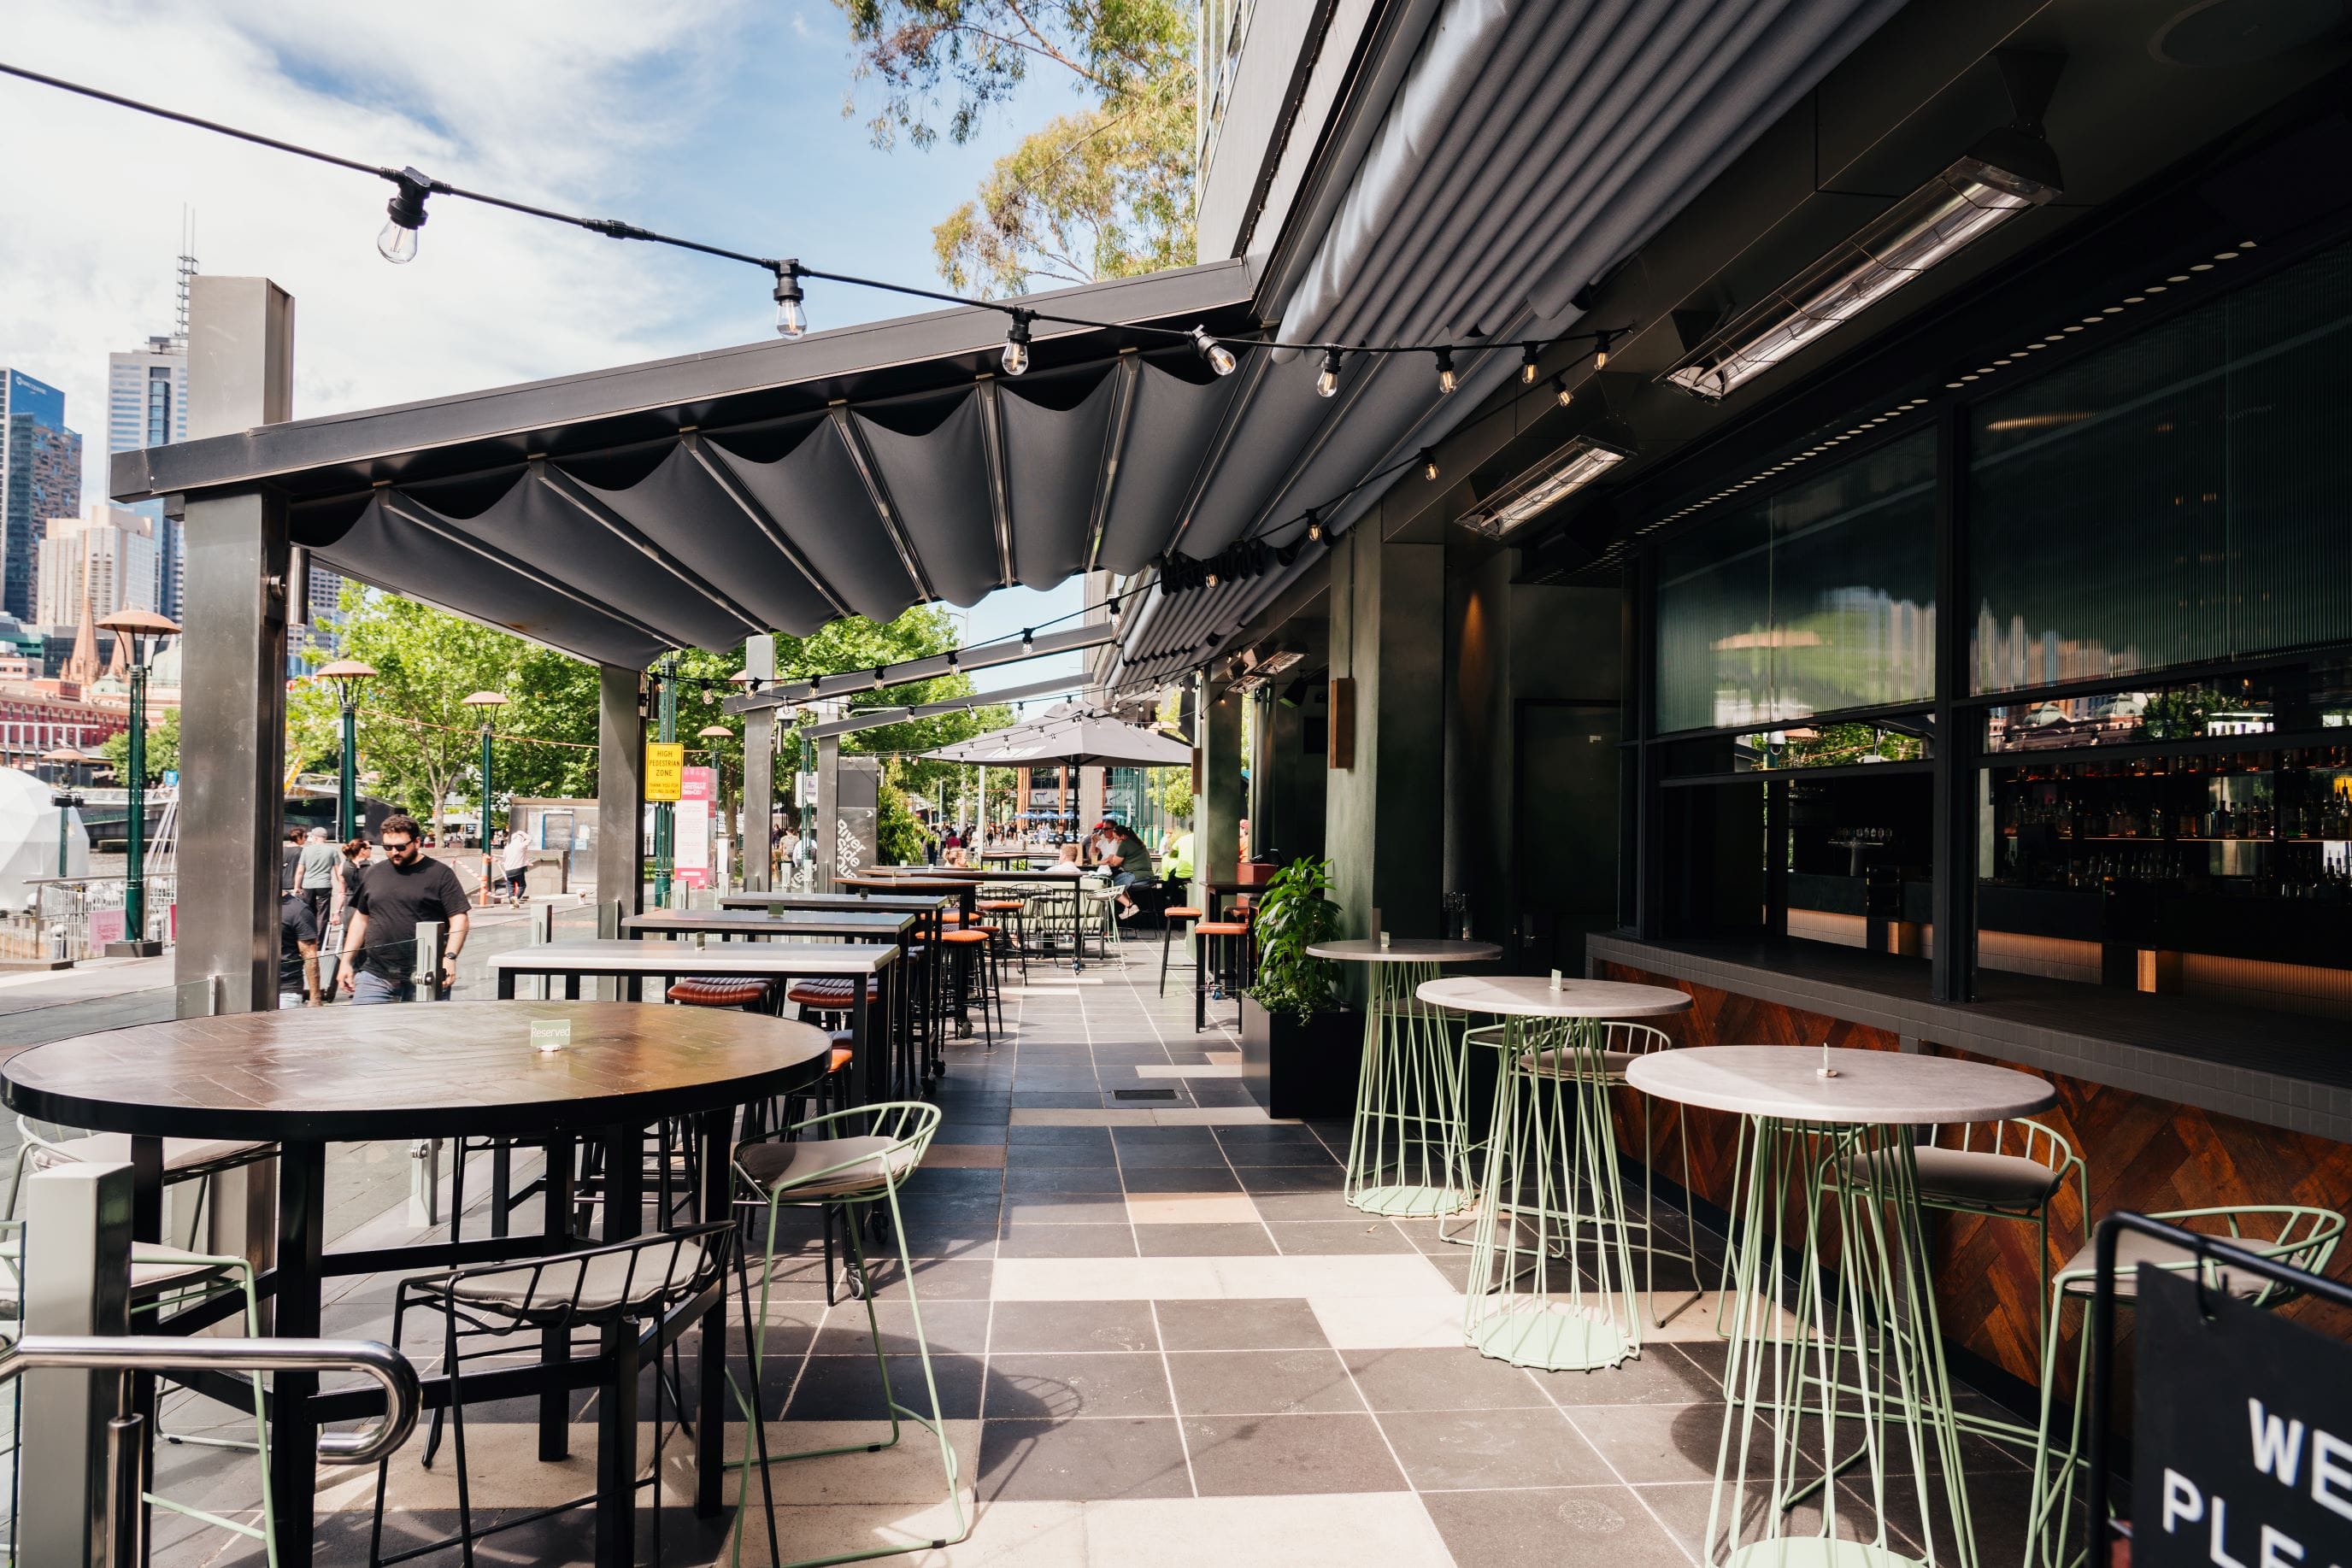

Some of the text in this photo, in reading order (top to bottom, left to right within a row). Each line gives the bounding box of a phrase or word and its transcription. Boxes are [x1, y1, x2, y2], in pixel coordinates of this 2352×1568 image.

[838, 819, 867, 853] River
[838, 837, 861, 867] Side
[532, 1025, 570, 1038] Reserved
[2162, 1467, 2343, 1568] PLE
